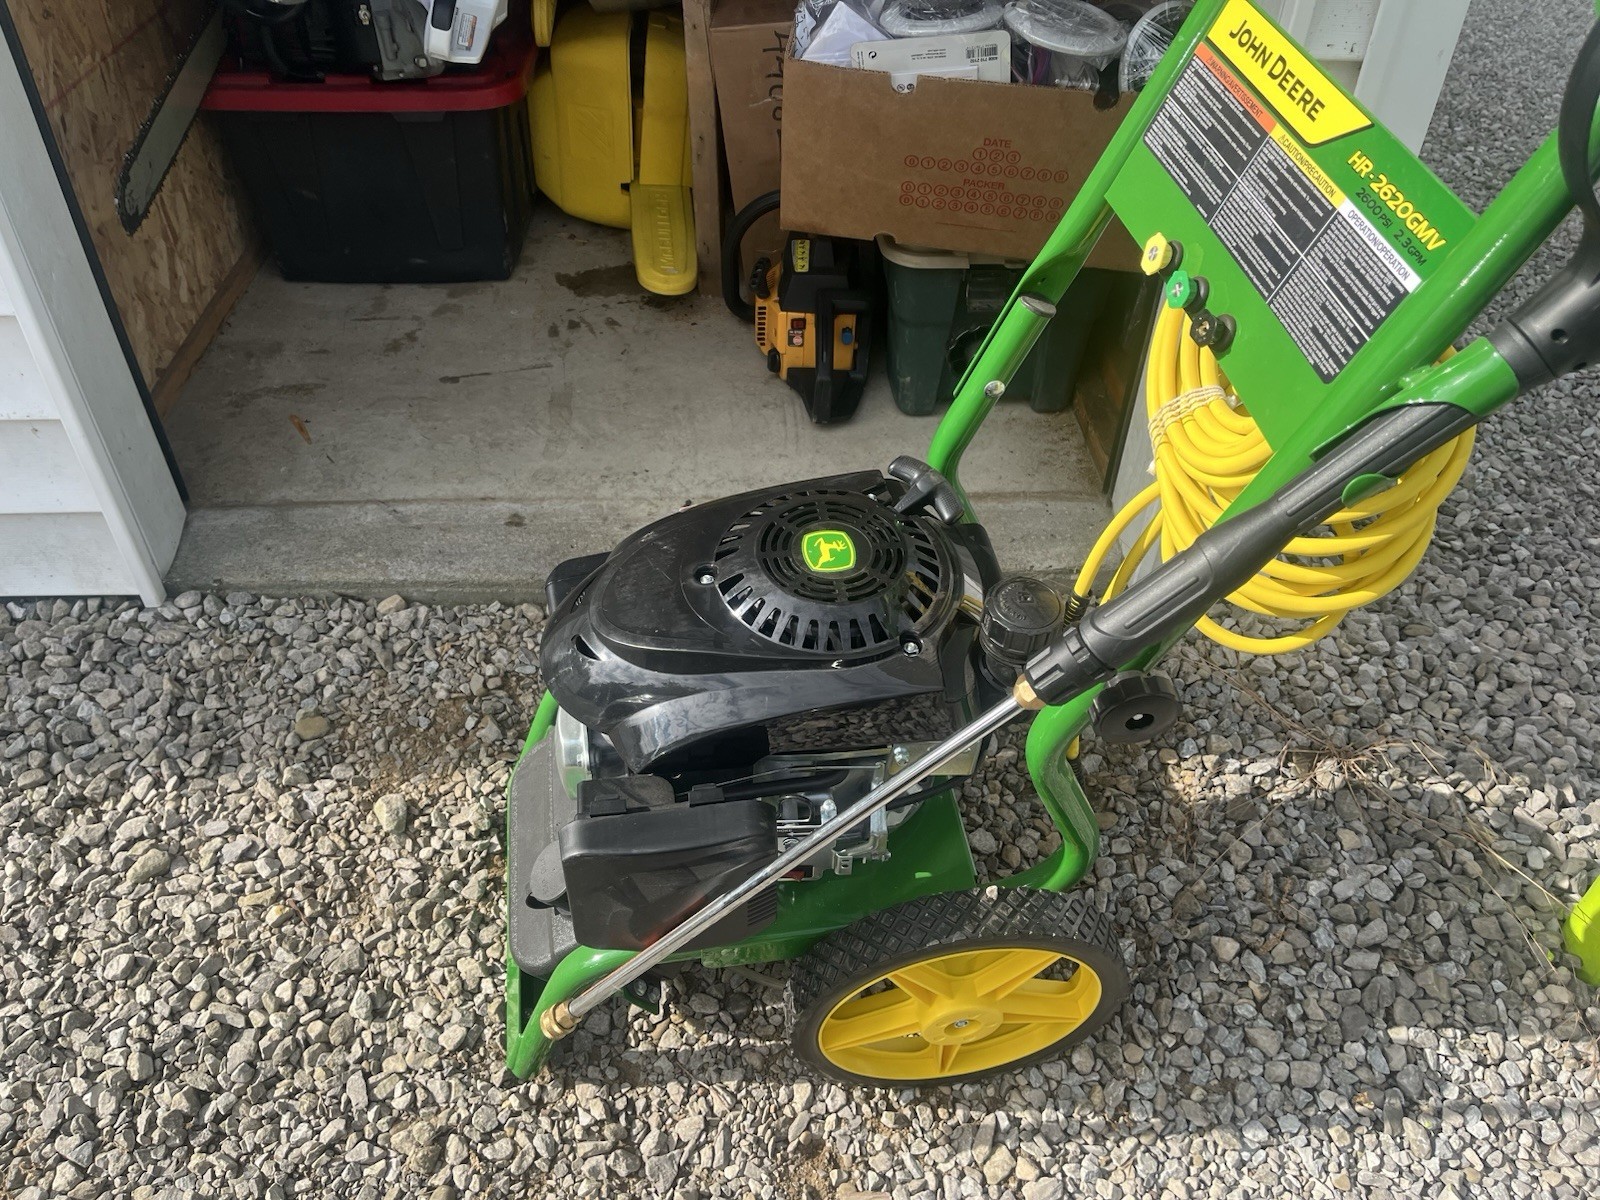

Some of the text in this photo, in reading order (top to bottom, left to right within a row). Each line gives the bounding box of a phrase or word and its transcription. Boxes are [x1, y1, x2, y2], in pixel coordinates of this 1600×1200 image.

[1209, 61, 1263, 119] WARNING/AVERTISSEMENT
[1228, 20, 1272, 70] JOHN
[1268, 54, 1325, 123] DEERE
[983, 138, 1012, 148] DATE
[1283, 138, 1337, 198] CAUTION/PRÉCAUTION
[963, 179, 1005, 190] PACKER
[1347, 209, 1411, 281] OPERATION/OPÉRATION
